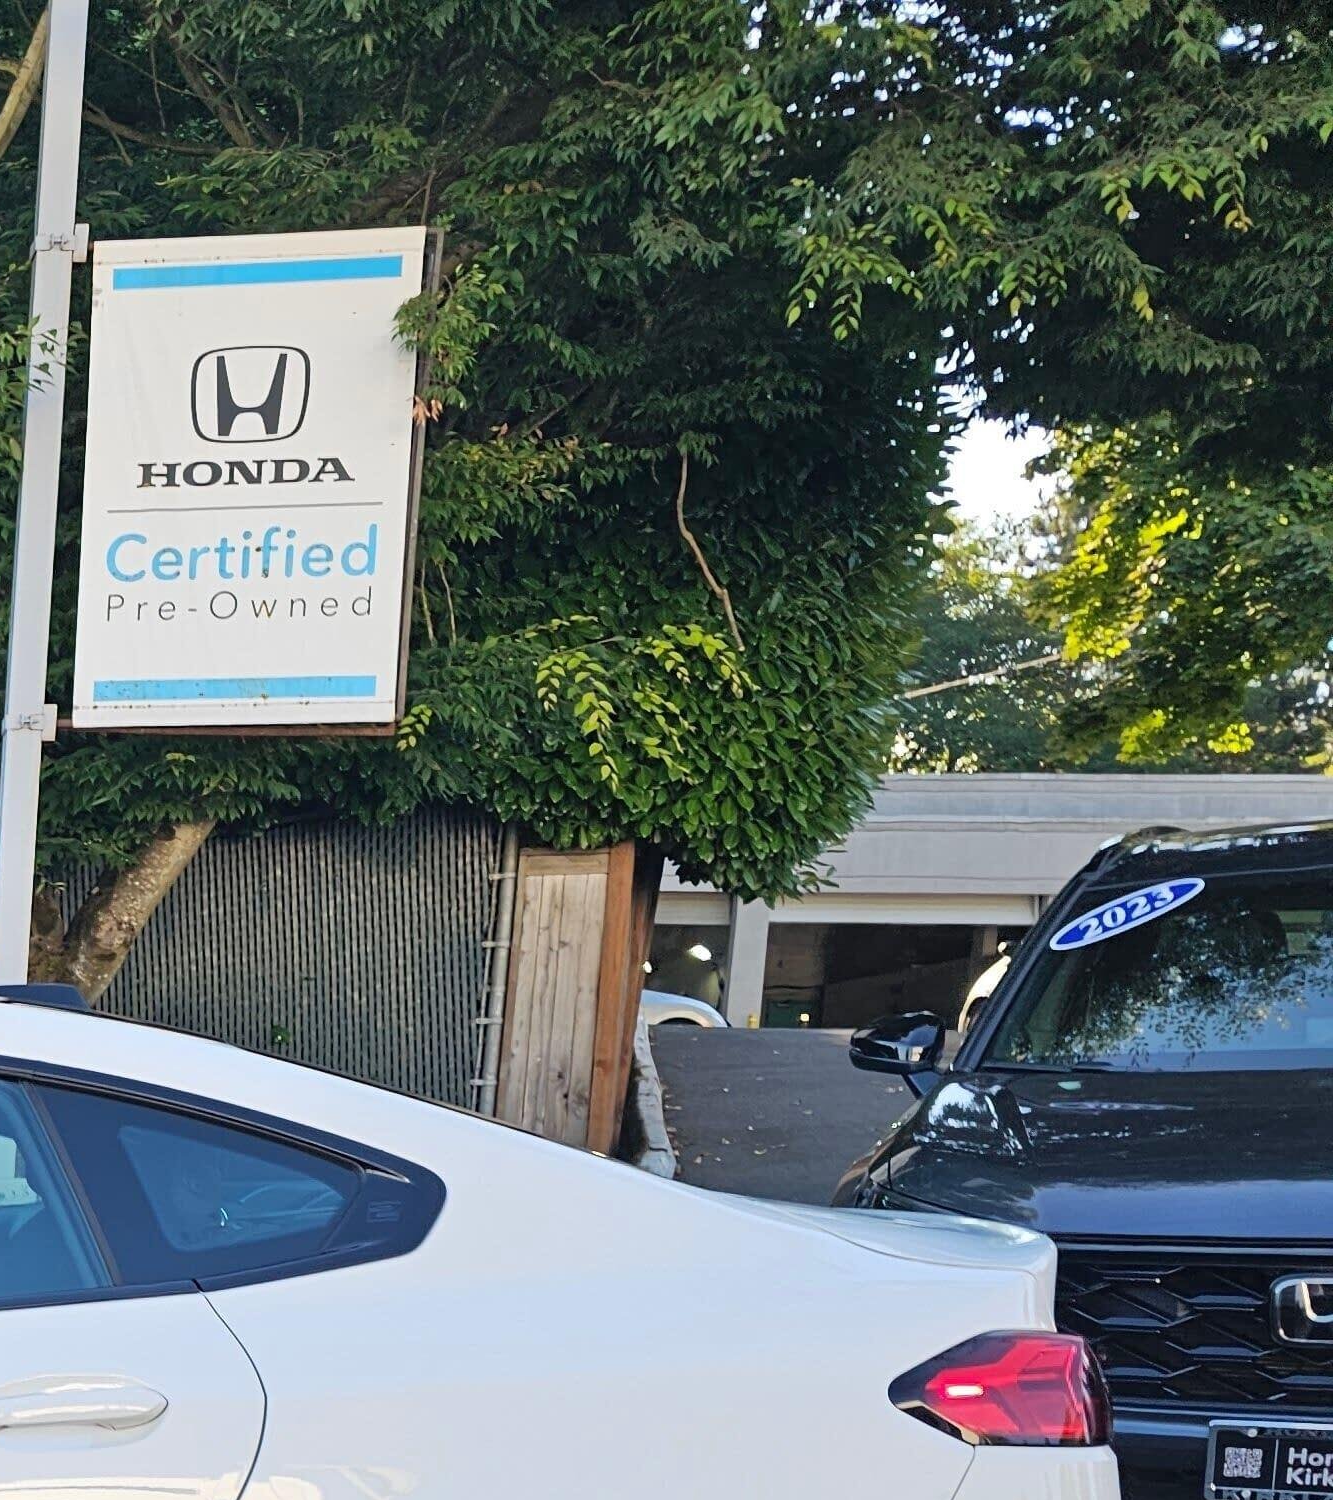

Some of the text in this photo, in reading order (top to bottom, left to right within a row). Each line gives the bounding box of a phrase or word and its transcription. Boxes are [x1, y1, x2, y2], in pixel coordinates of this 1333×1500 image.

[136, 457, 356, 489] HONDA
[106, 523, 378, 583] Certified
[107, 586, 372, 622] Pre-Owned
[1079, 885, 1175, 940] 2023
